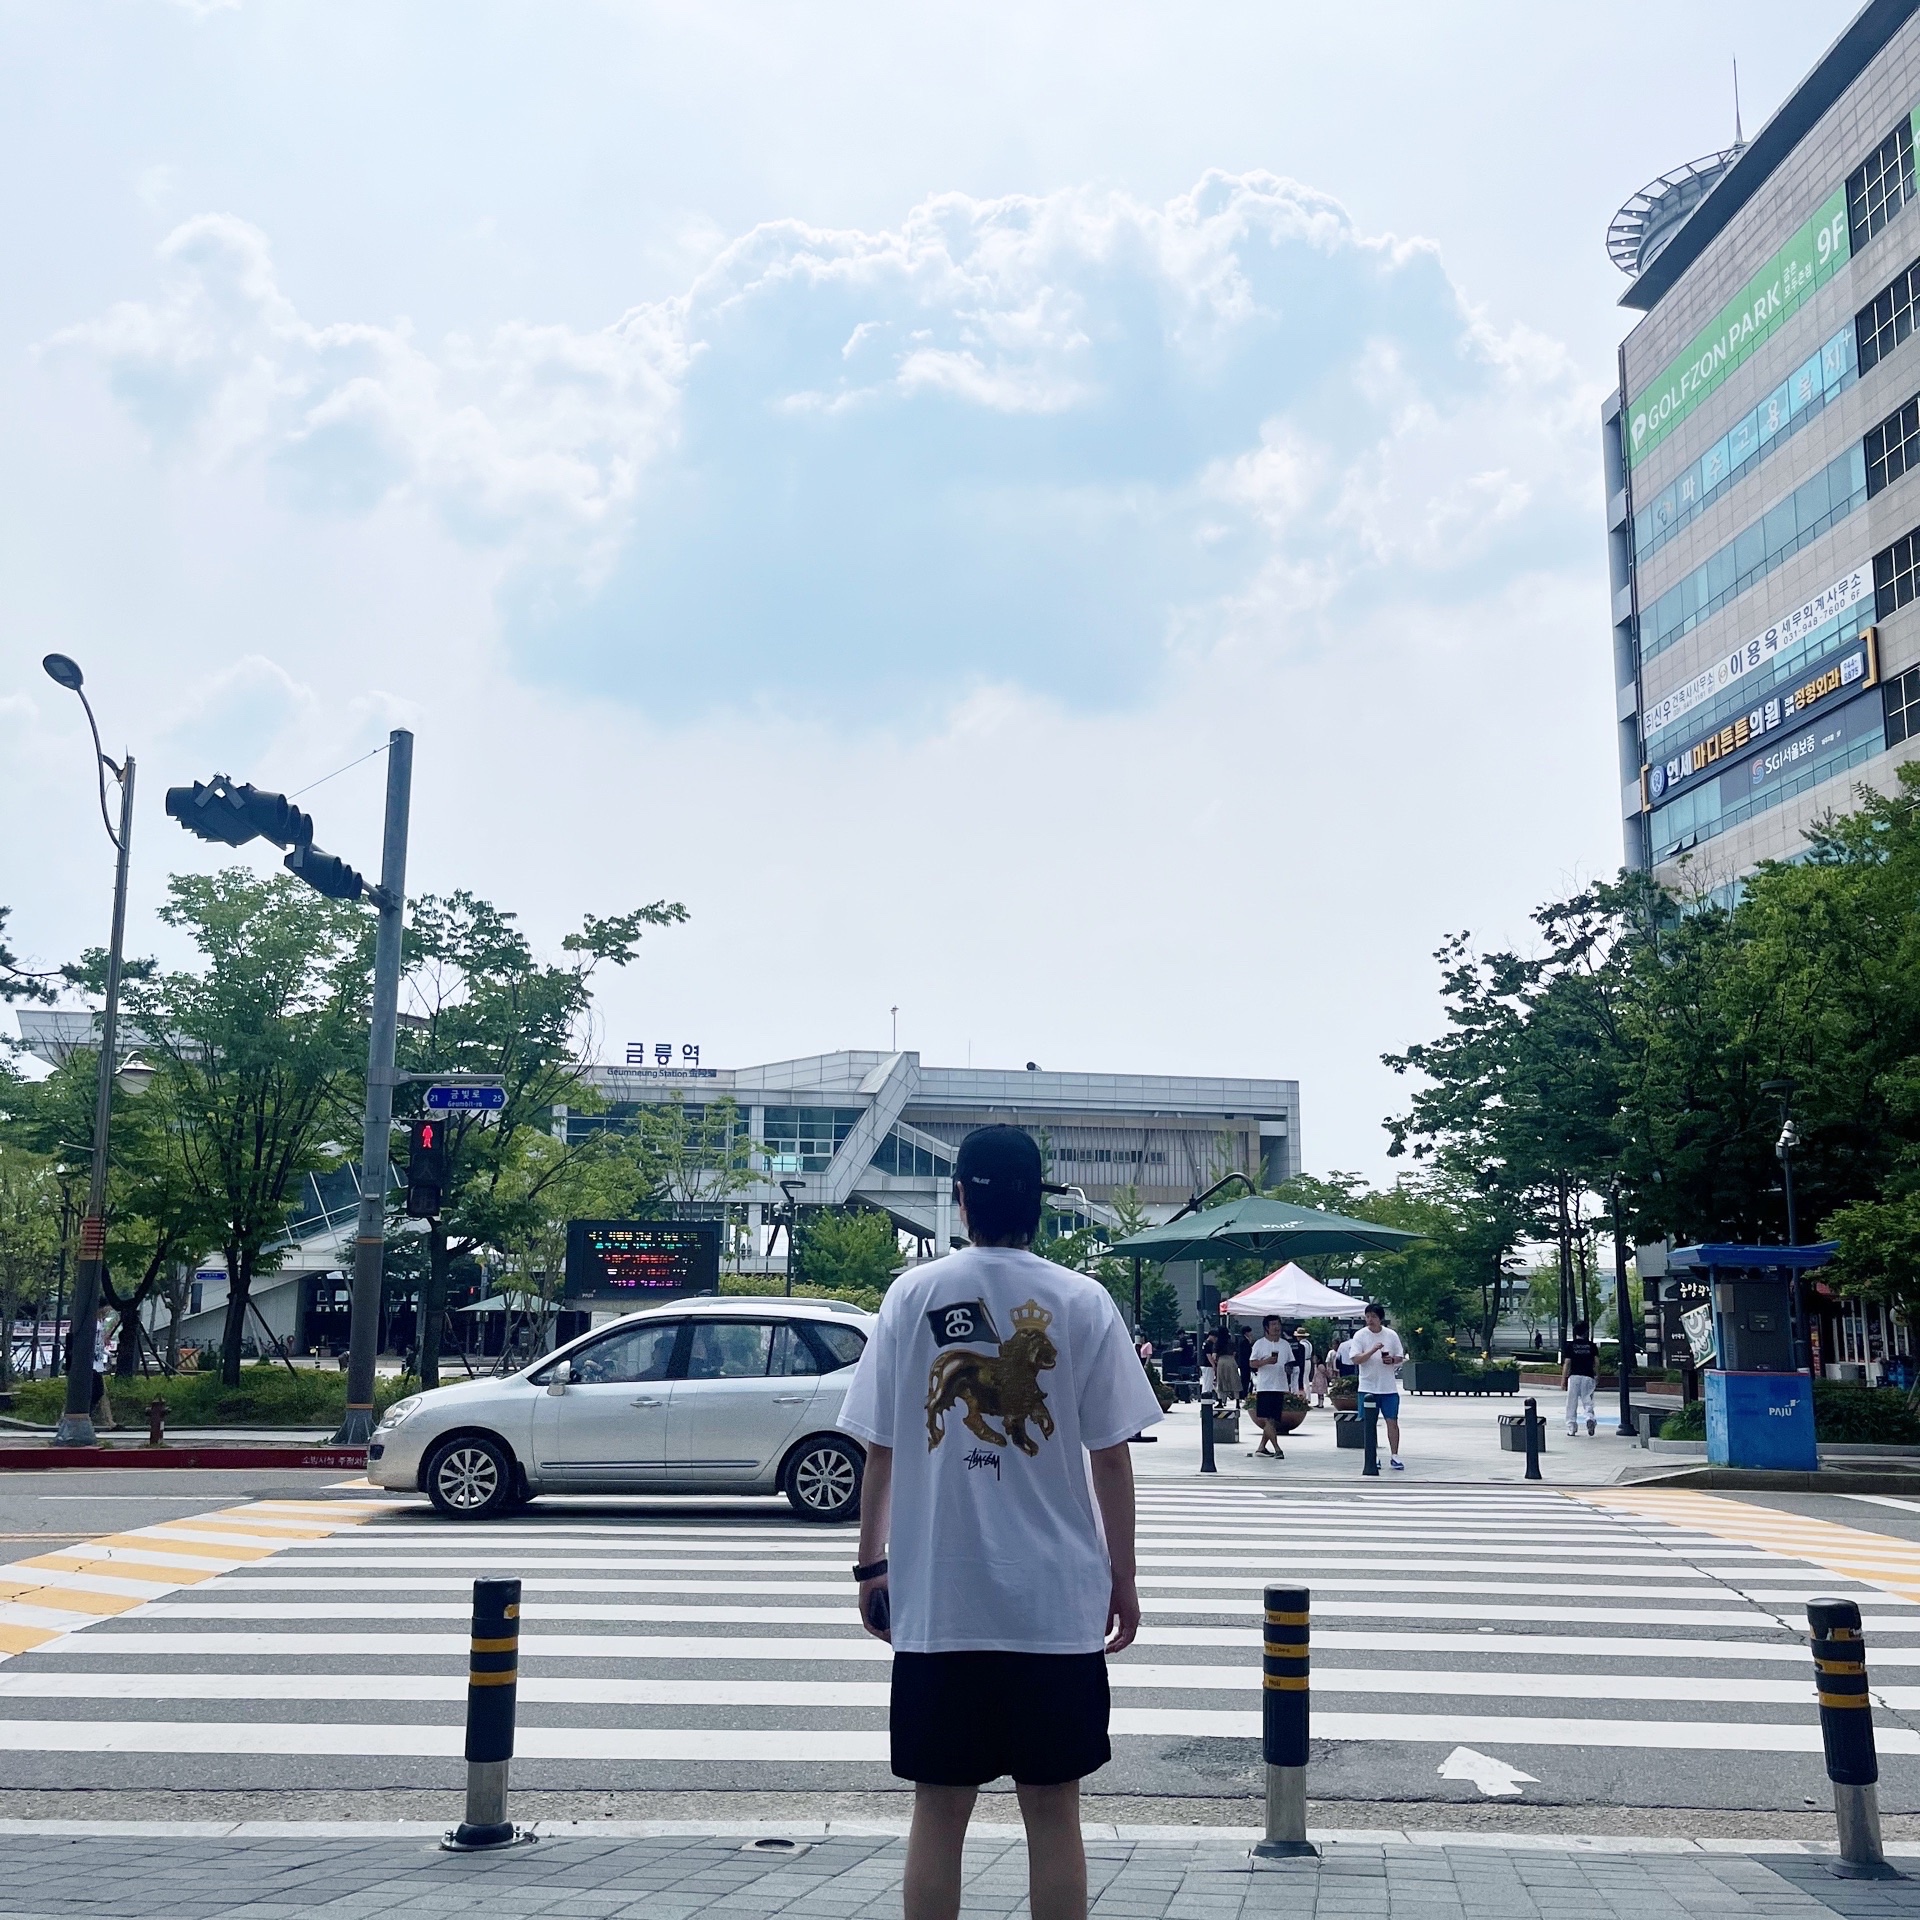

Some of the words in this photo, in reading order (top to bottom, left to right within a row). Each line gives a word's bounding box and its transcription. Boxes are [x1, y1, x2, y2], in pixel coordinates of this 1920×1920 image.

[1817, 210, 1844, 265] 9F
[1648, 336, 1727, 430] GOLFZON
[1729, 280, 1781, 352] PARK
[1730, 628, 1779, 676] 이용욱
[1781, 573, 1862, 634] 세무회계사무소
[1783, 598, 1846, 645] 031-948-7600
[1850, 588, 1860, 601] 6F
[1794, 667, 1841, 710] 정형외과
[626, 1042, 700, 1066] 금릉역
[659, 1069, 688, 1078] Station
[430, 1094, 439, 1102] 21
[450, 1089, 481, 1100] 금빛로
[492, 1094, 503, 1103] 25
[1768, 1407, 1792, 1417] PAJU
